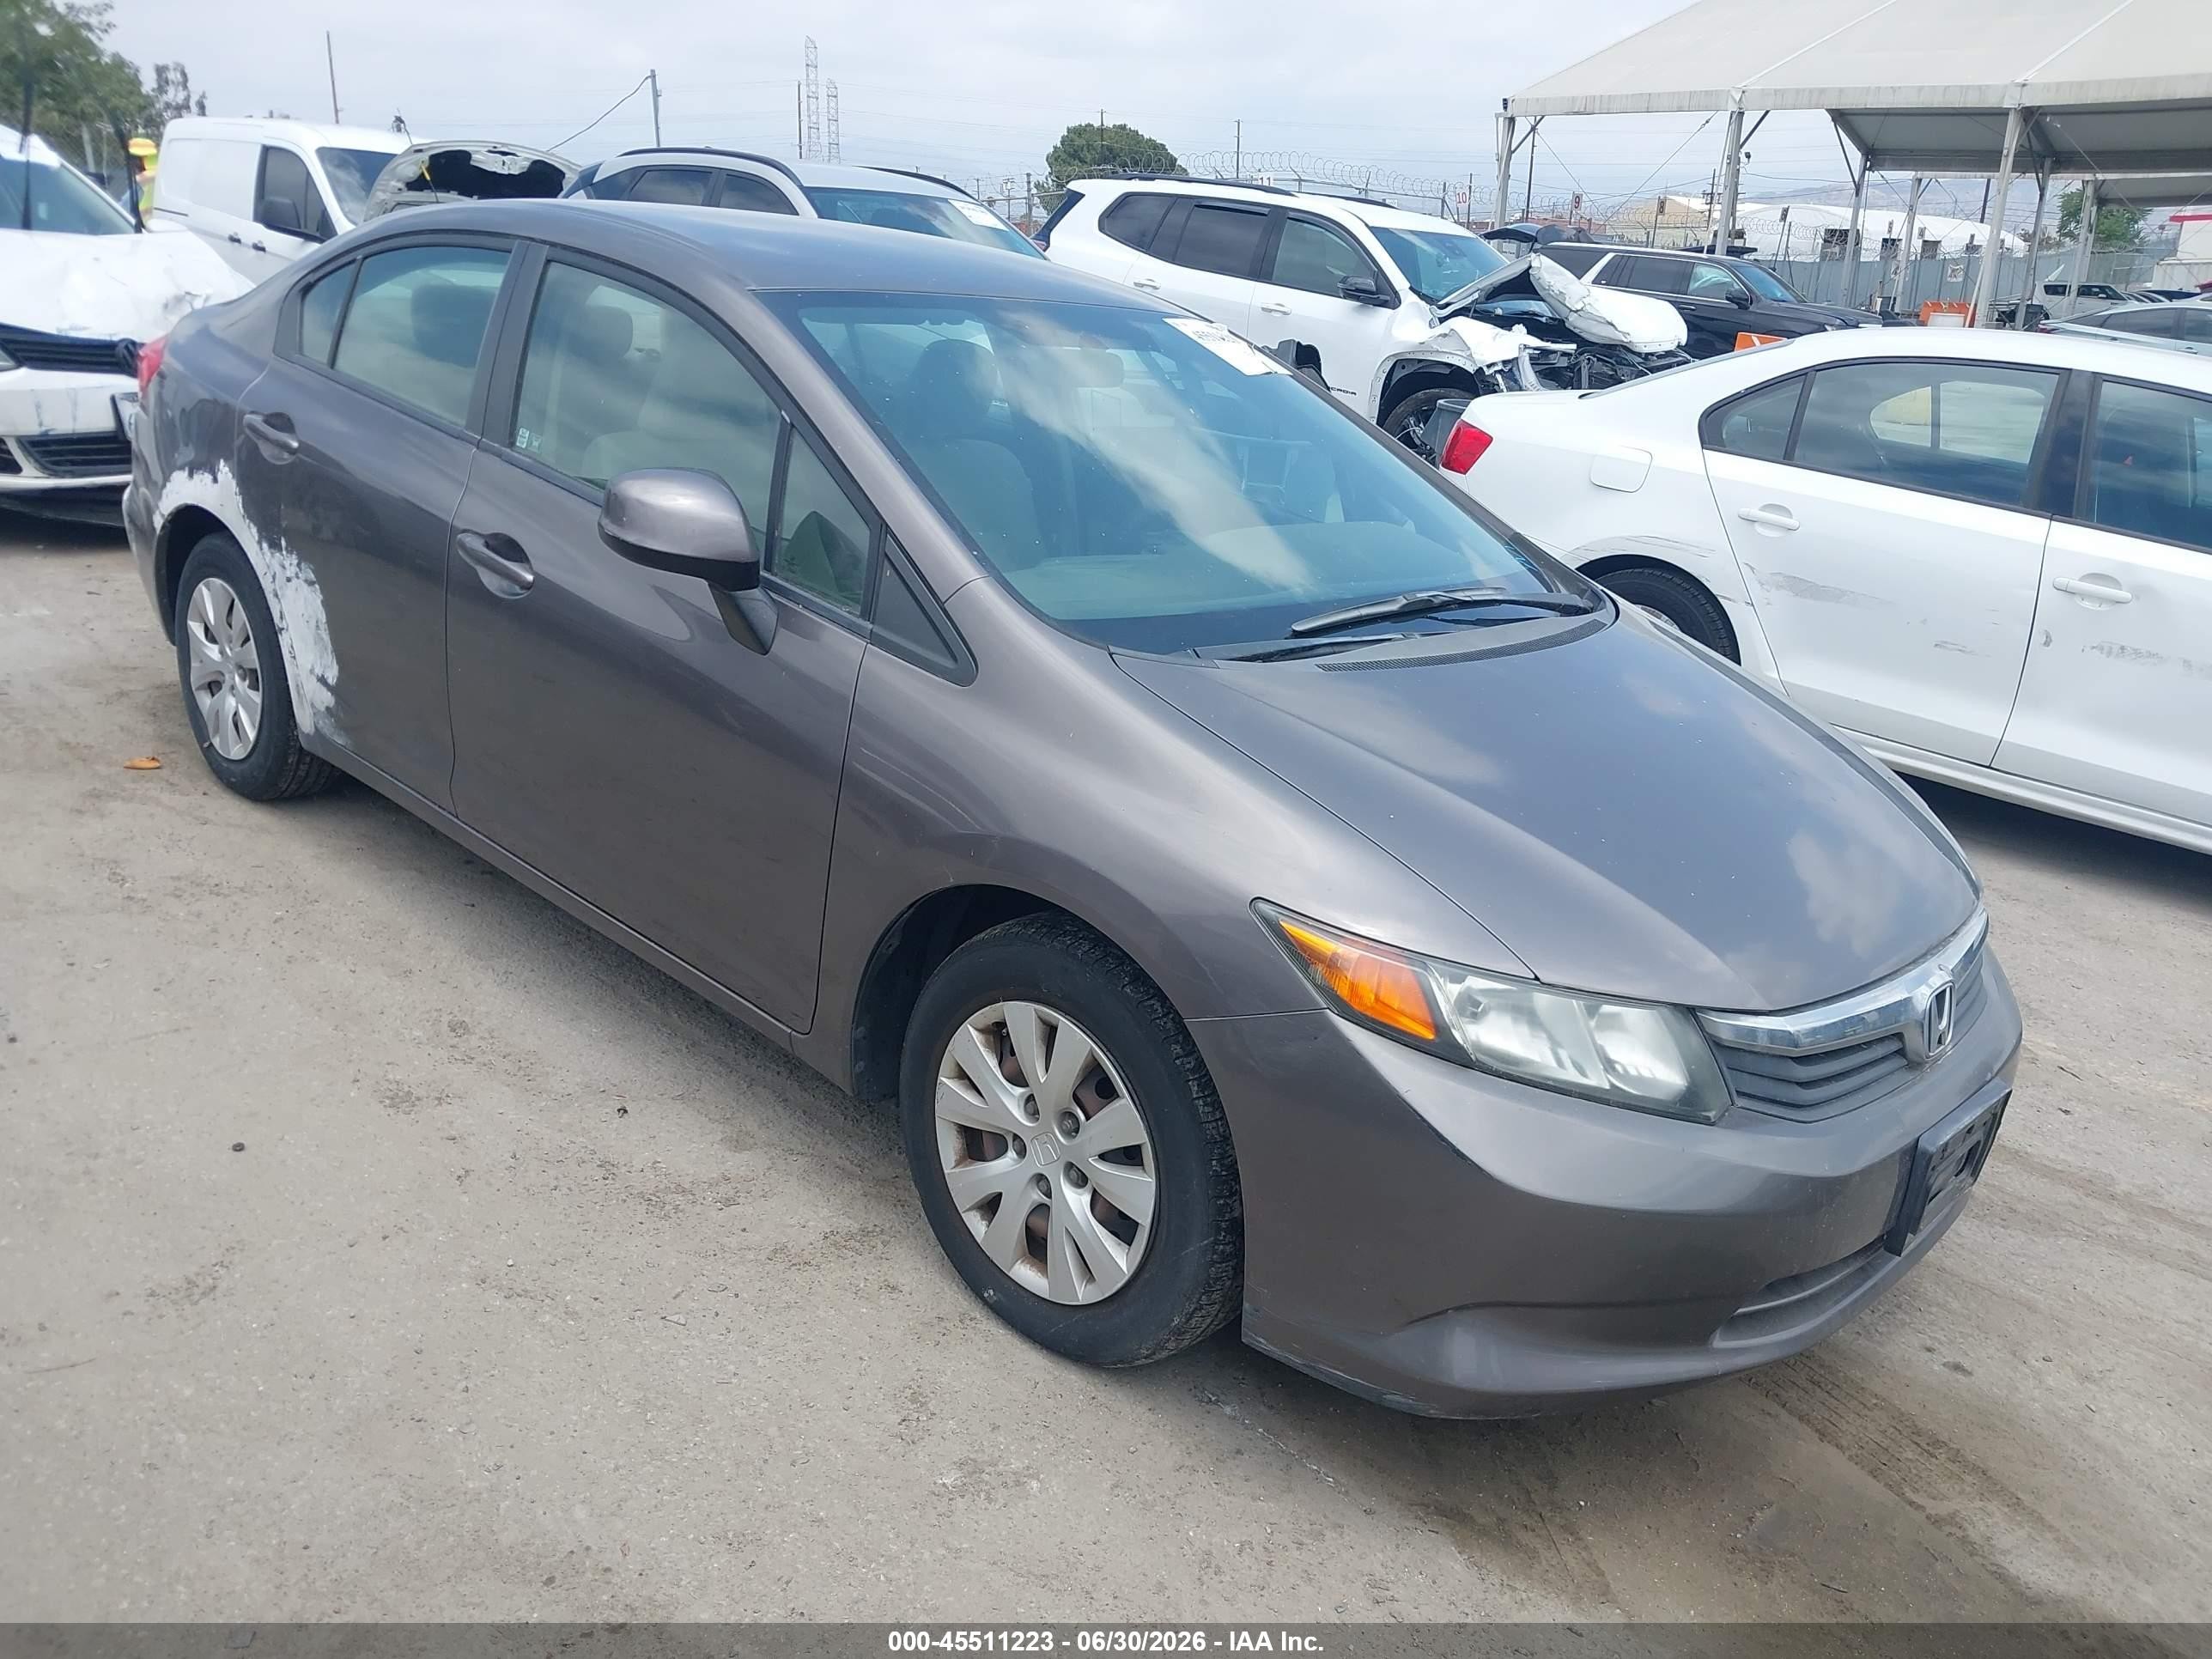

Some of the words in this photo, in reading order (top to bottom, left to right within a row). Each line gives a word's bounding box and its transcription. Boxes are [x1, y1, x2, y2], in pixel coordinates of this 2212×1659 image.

[1456, 191, 1468, 204] 10
[1574, 195, 1581, 209] 9
[1658, 200, 1665, 214] 8
[1330, 386, 1357, 396] CADIA
